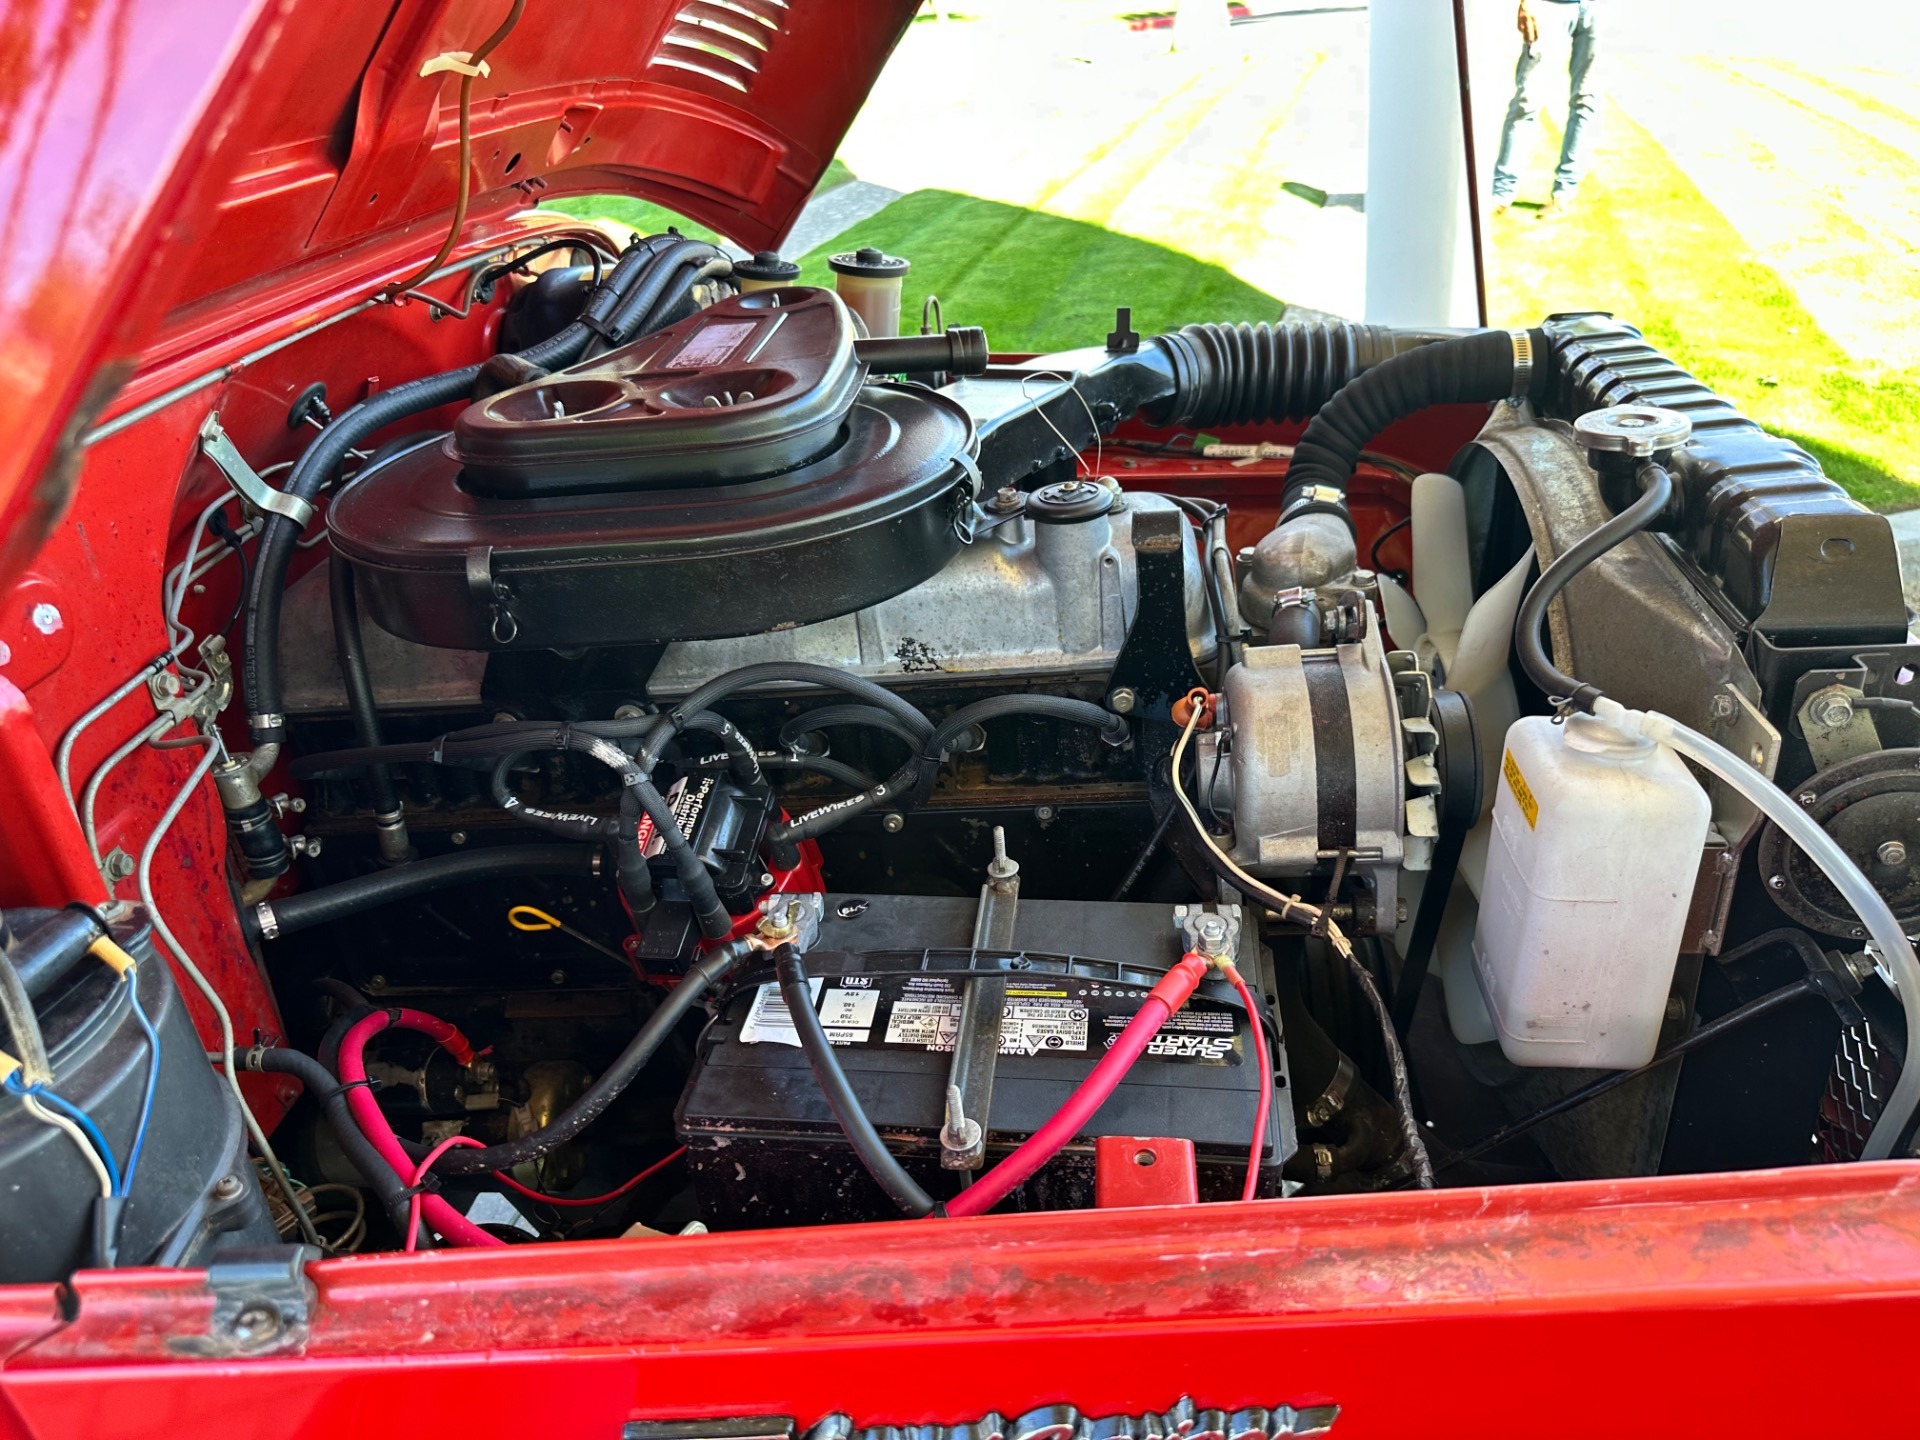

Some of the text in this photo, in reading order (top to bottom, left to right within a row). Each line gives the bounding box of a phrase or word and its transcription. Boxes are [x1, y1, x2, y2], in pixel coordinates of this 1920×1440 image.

[504, 796, 598, 825] LIVEWIRES 4
[676, 794, 696, 833] Distrib
[682, 785, 710, 840] Performan
[790, 784, 885, 828] LIVEWIRES 3
[1146, 1036, 1234, 1050] START
[1147, 1046, 1224, 1059] SUPER
